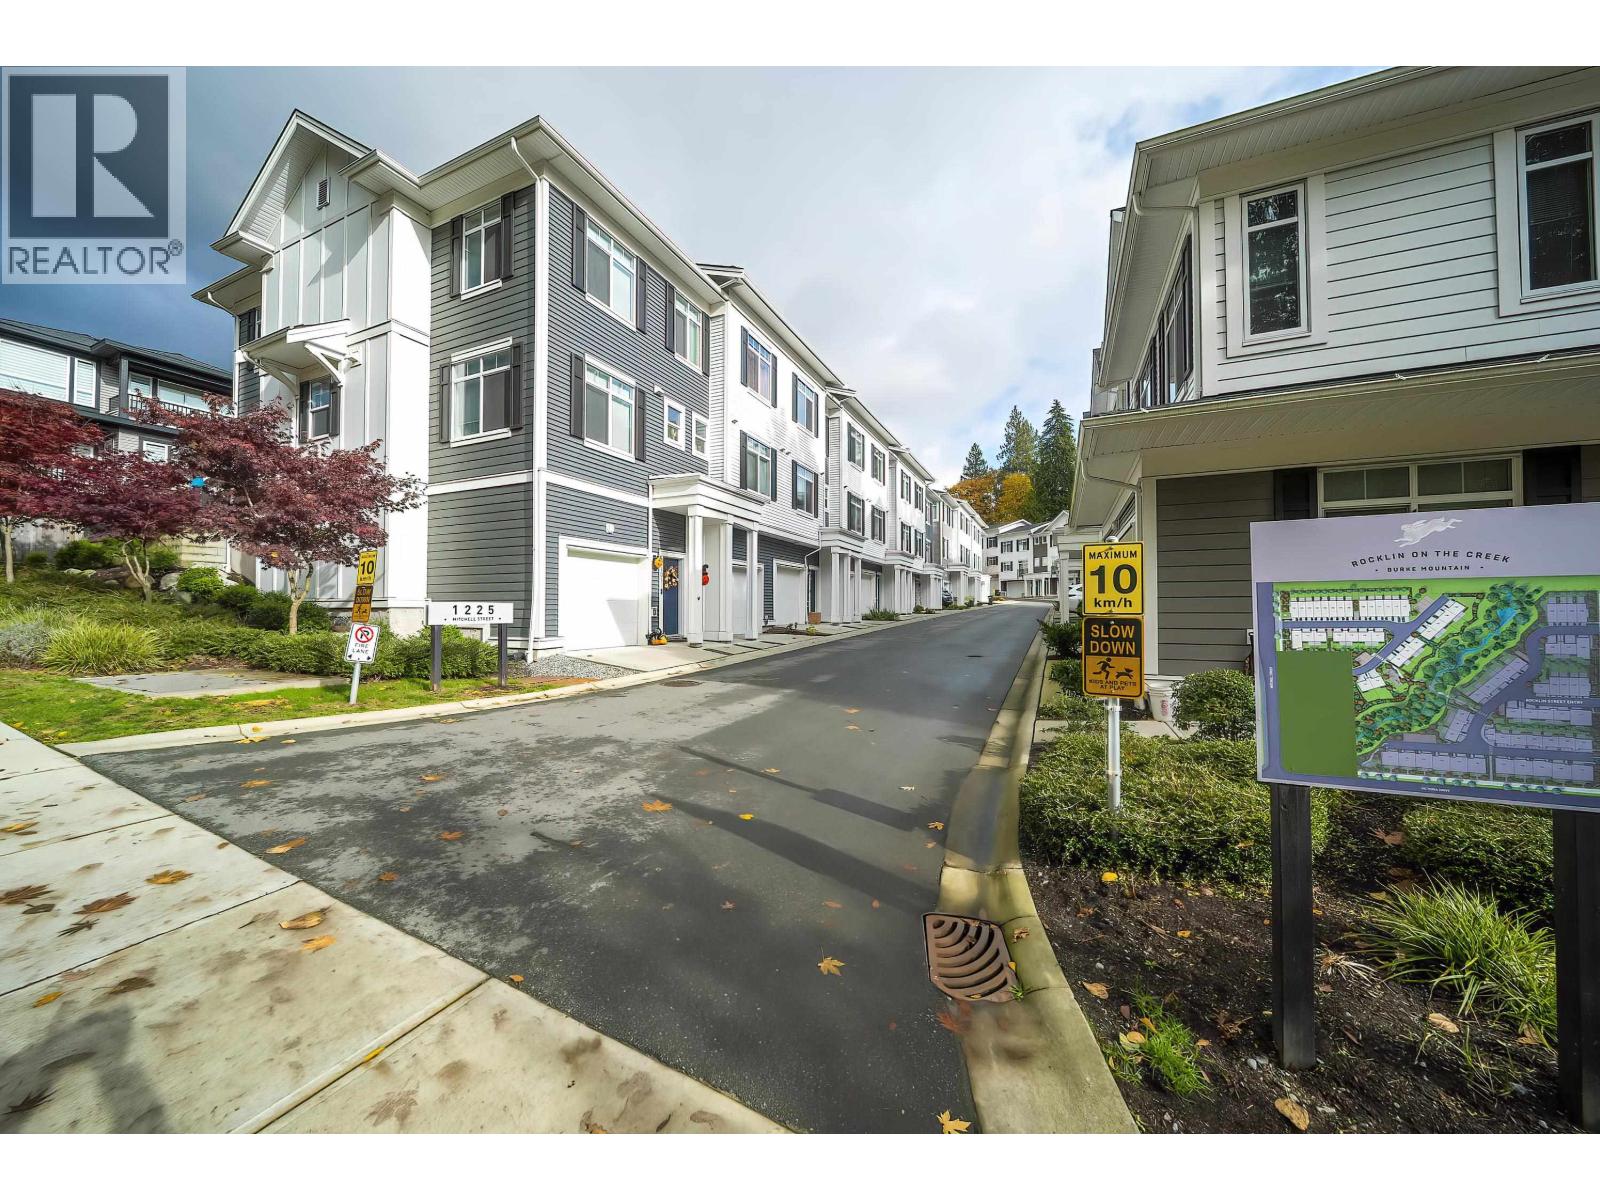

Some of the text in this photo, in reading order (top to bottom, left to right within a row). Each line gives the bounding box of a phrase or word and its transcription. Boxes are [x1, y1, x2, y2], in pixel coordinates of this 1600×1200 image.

[1088, 550, 1137, 560] MAXIMUM
[1351, 552, 1405, 568] ROCKLIN
[1466, 551, 1511, 563] CREEK
[361, 560, 375, 575] 10
[1090, 563, 1138, 595] 10
[1094, 597, 1133, 608] km/h
[1090, 624, 1135, 639] SLOW
[1090, 640, 1136, 656] DOWN
